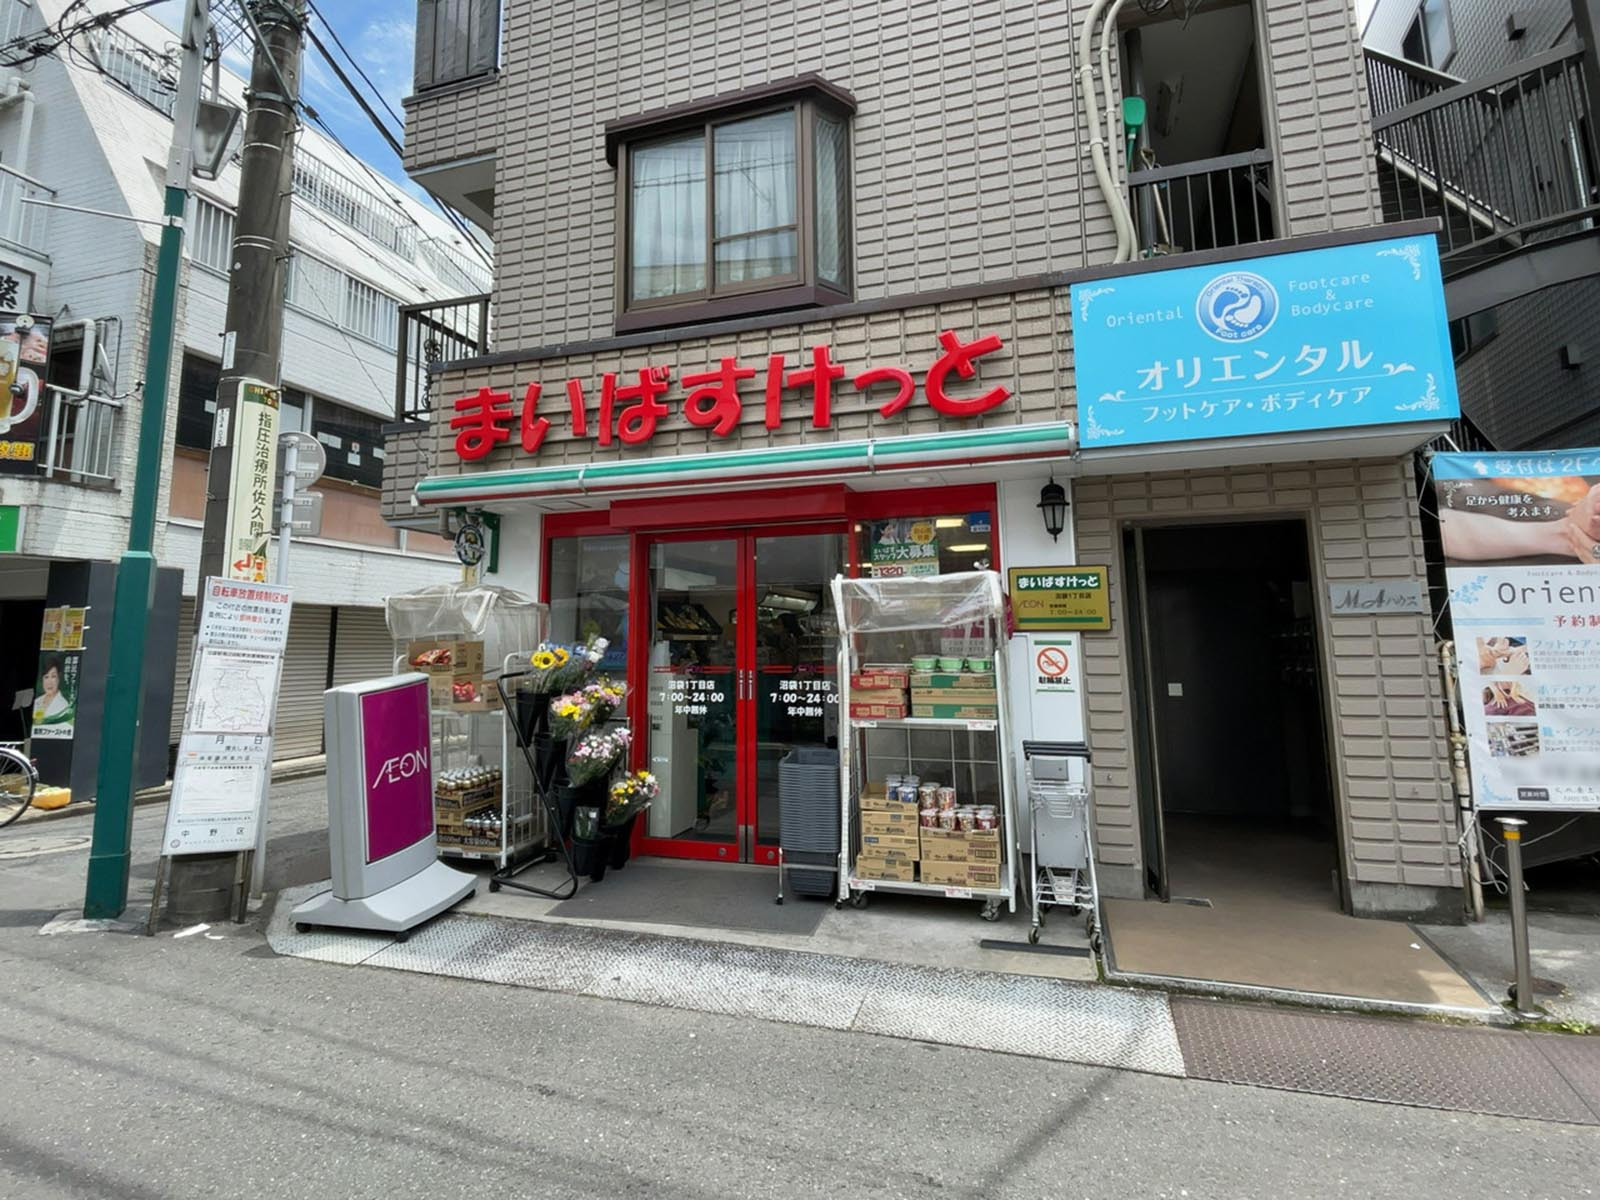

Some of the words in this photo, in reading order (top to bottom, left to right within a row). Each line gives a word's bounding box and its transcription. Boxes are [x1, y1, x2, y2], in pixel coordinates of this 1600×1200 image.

[1288, 270, 1371, 293] Footcare
[1324, 289, 1337, 302] &
[1290, 294, 1375, 317] Bodycare
[1105, 304, 1184, 328] Oriental
[1215, 327, 1239, 338] Foot
[1240, 324, 1263, 339] care
[1135, 339, 1374, 392] オリエンタル
[450, 329, 1012, 461] まいばすけっと
[1142, 386, 1372, 423] フットケア・ボディケア
[1466, 494, 1534, 507] 足から健康を
[1507, 506, 1560, 518] 考えます。
[897, 543, 936, 560] 大募集
[880, 566, 904, 577] 1320
[1018, 575, 1099, 589] まいばすけっと
[1497, 580, 1600, 605] Orien
[668, 680, 715, 691] 沼袋1丁目店
[779, 679, 831, 691] 沼袋1丁目店
[674, 704, 708, 715] 年中無休
[787, 705, 823, 717] 年中無休
[254, 735, 263, 745] 日
